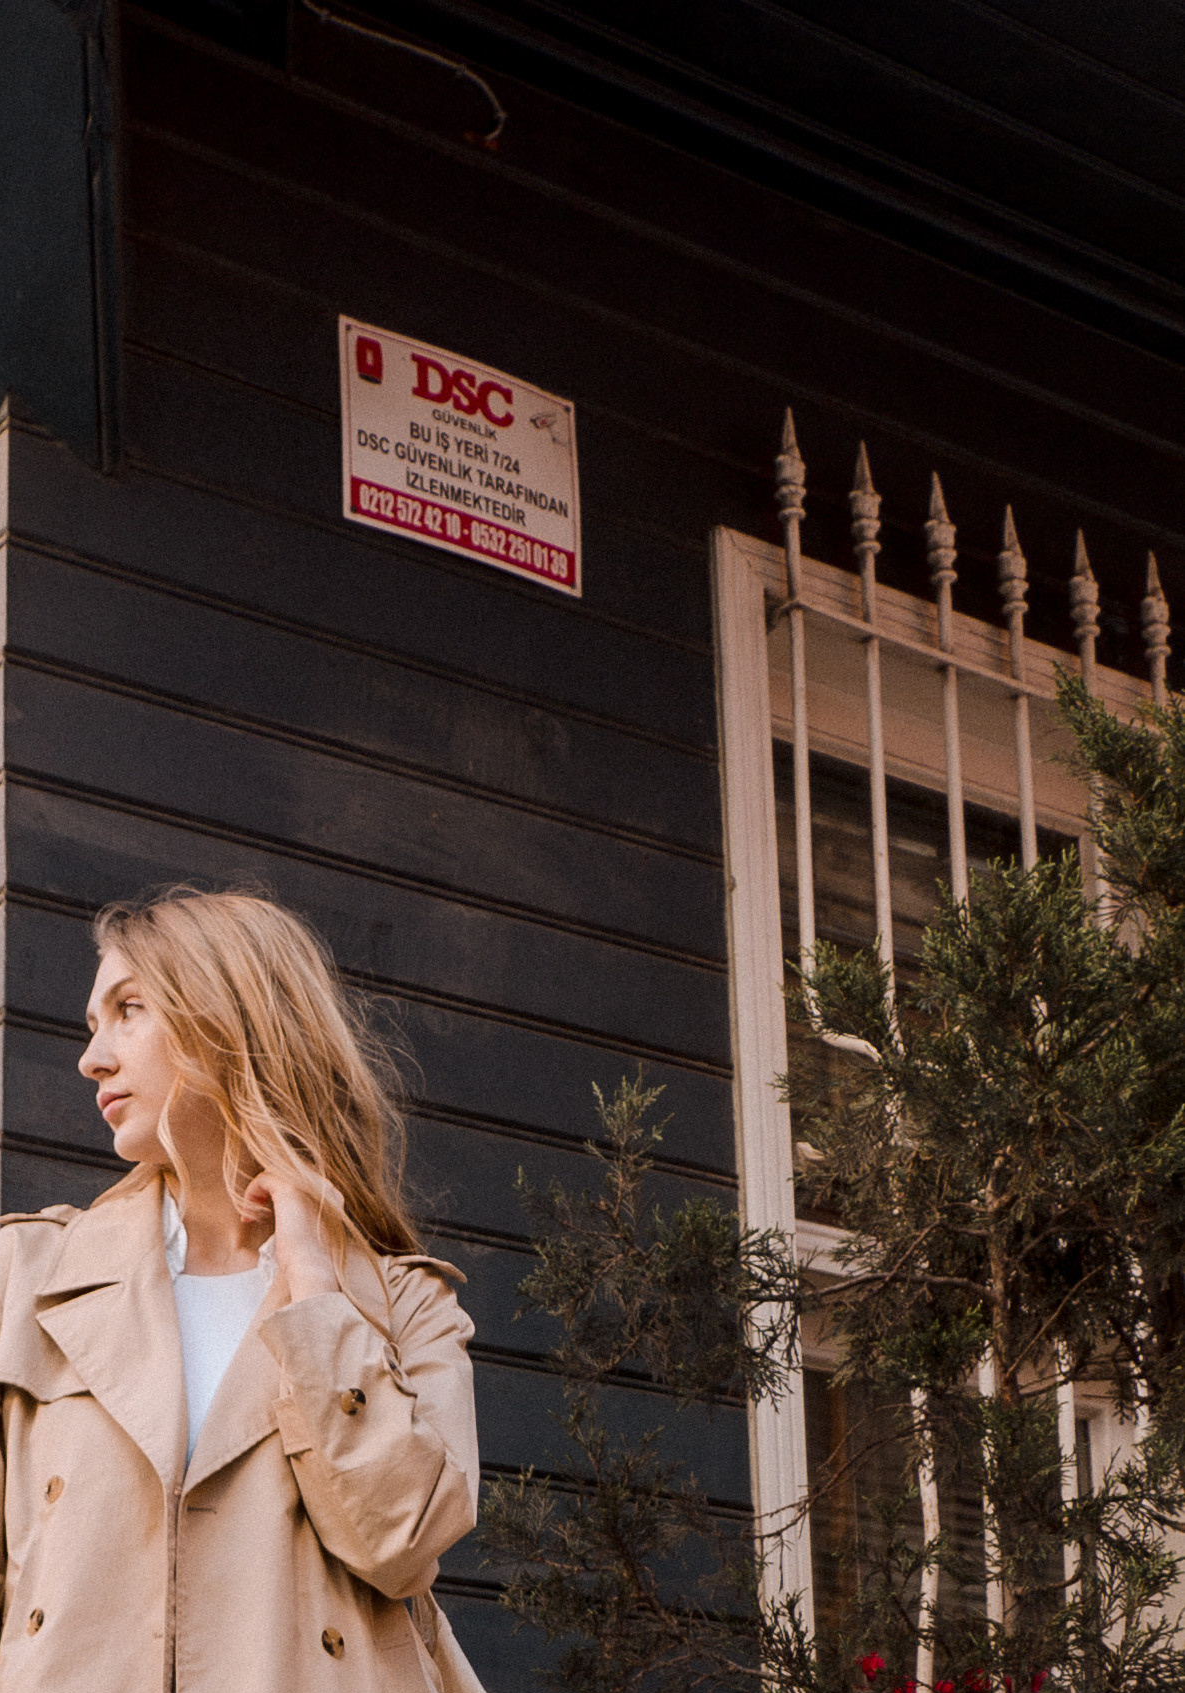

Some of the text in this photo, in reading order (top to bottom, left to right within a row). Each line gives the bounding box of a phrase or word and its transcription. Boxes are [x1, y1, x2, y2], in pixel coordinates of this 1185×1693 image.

[411, 353, 514, 428] DSC
[410, 421, 431, 443] BU
[436, 426, 450, 453] İŞ
[454, 436, 488, 464] YERİ
[357, 429, 569, 518] DSC GÜVENLİK TARAFINDAN
[359, 483, 395, 518] 0212
[406, 466, 526, 527] İZLENMEKTEDİR
